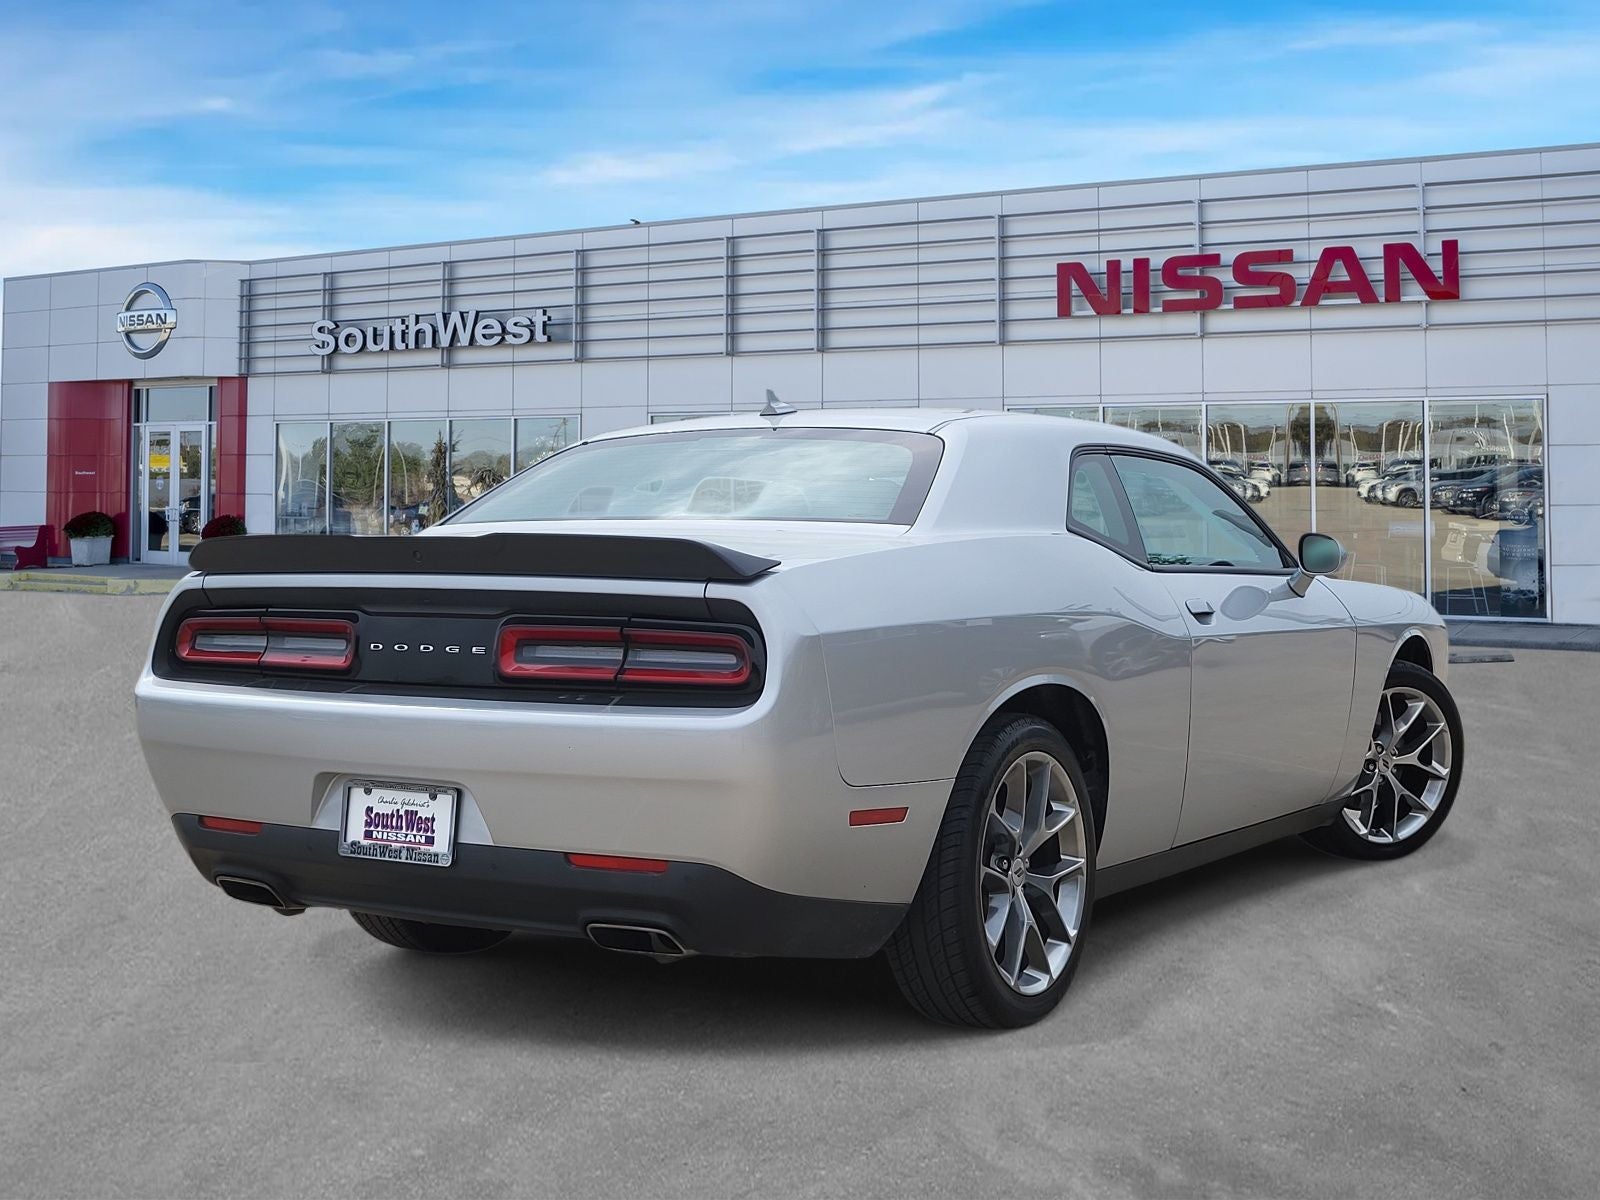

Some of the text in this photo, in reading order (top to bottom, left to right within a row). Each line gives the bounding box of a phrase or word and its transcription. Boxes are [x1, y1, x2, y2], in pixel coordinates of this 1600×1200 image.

[1056, 239, 1461, 318] NISSAN
[119, 313, 167, 328] NISSAN
[308, 309, 551, 356] SouthWest
[370, 643, 487, 655] DODGE
[364, 806, 436, 834] SouthWest
[372, 831, 426, 844] NISSAN
[349, 841, 439, 864] SouthWest Nissan
